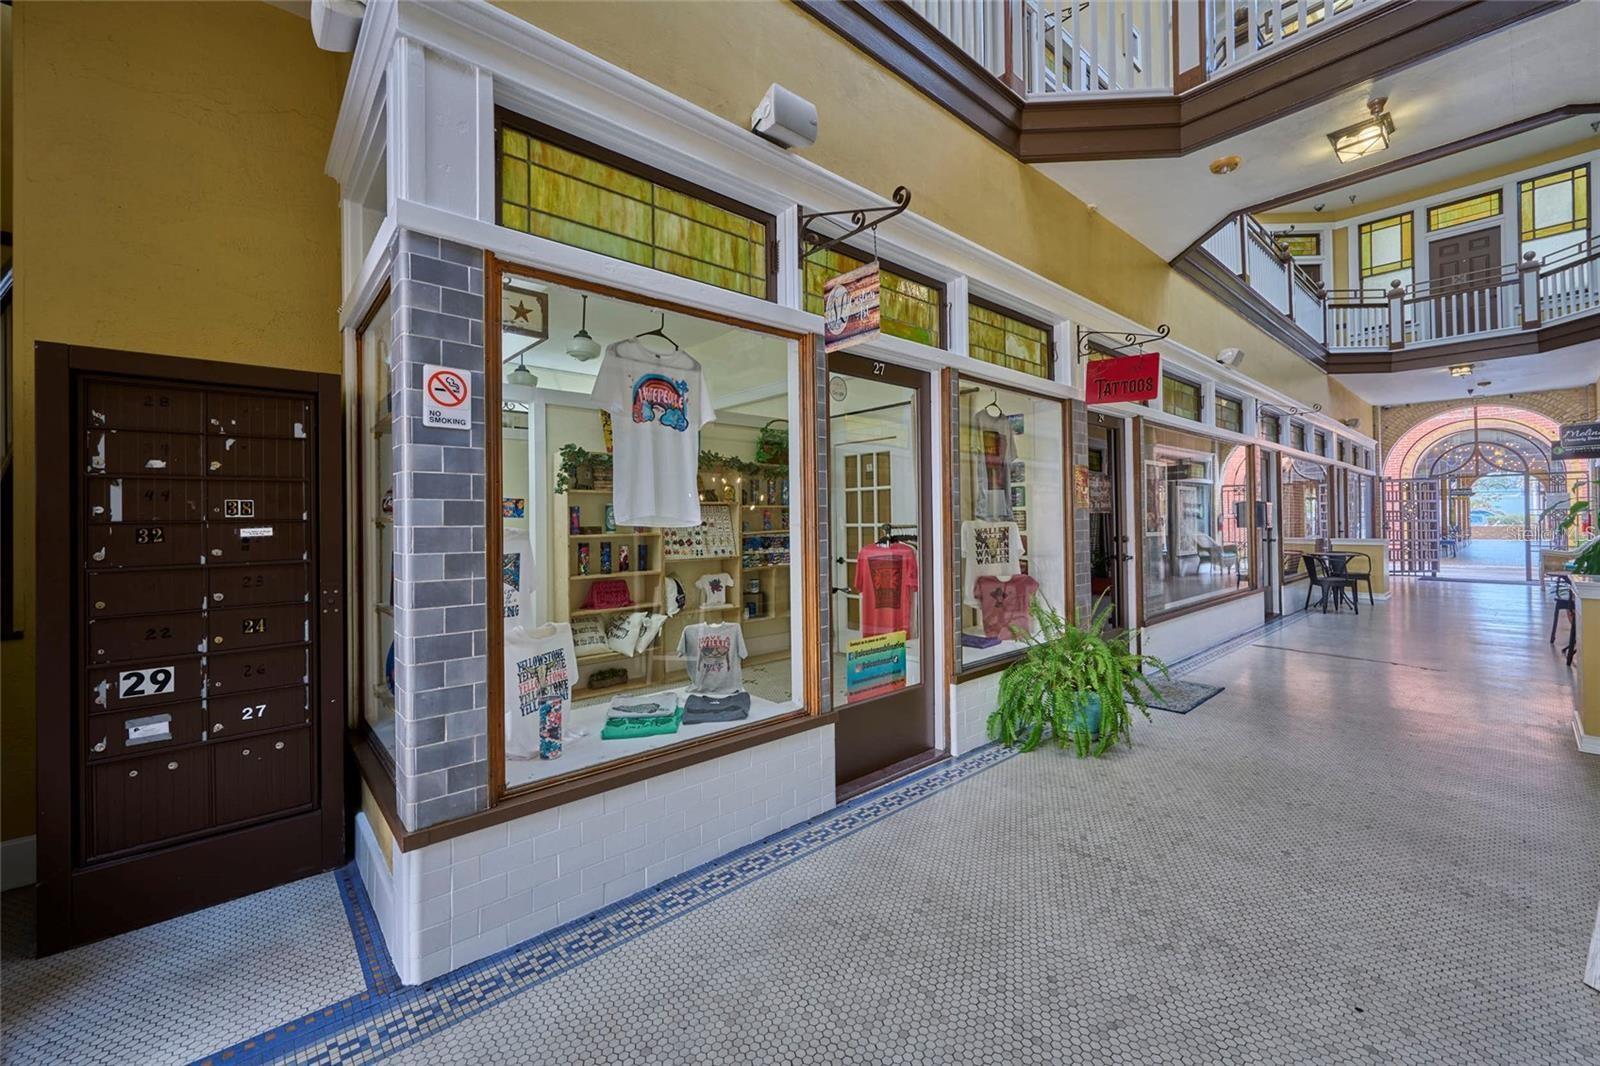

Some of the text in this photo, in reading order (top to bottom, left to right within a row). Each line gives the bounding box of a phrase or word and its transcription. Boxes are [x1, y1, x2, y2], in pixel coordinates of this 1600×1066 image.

[873, 361, 885, 376] 27
[1094, 377, 1153, 400] TATTOOS
[429, 416, 467, 426] SMOKING
[226, 501, 253, 516] 38
[137, 528, 164, 544] 32
[243, 619, 267, 634] 24
[122, 669, 173, 697] 29
[242, 704, 267, 720] 27
